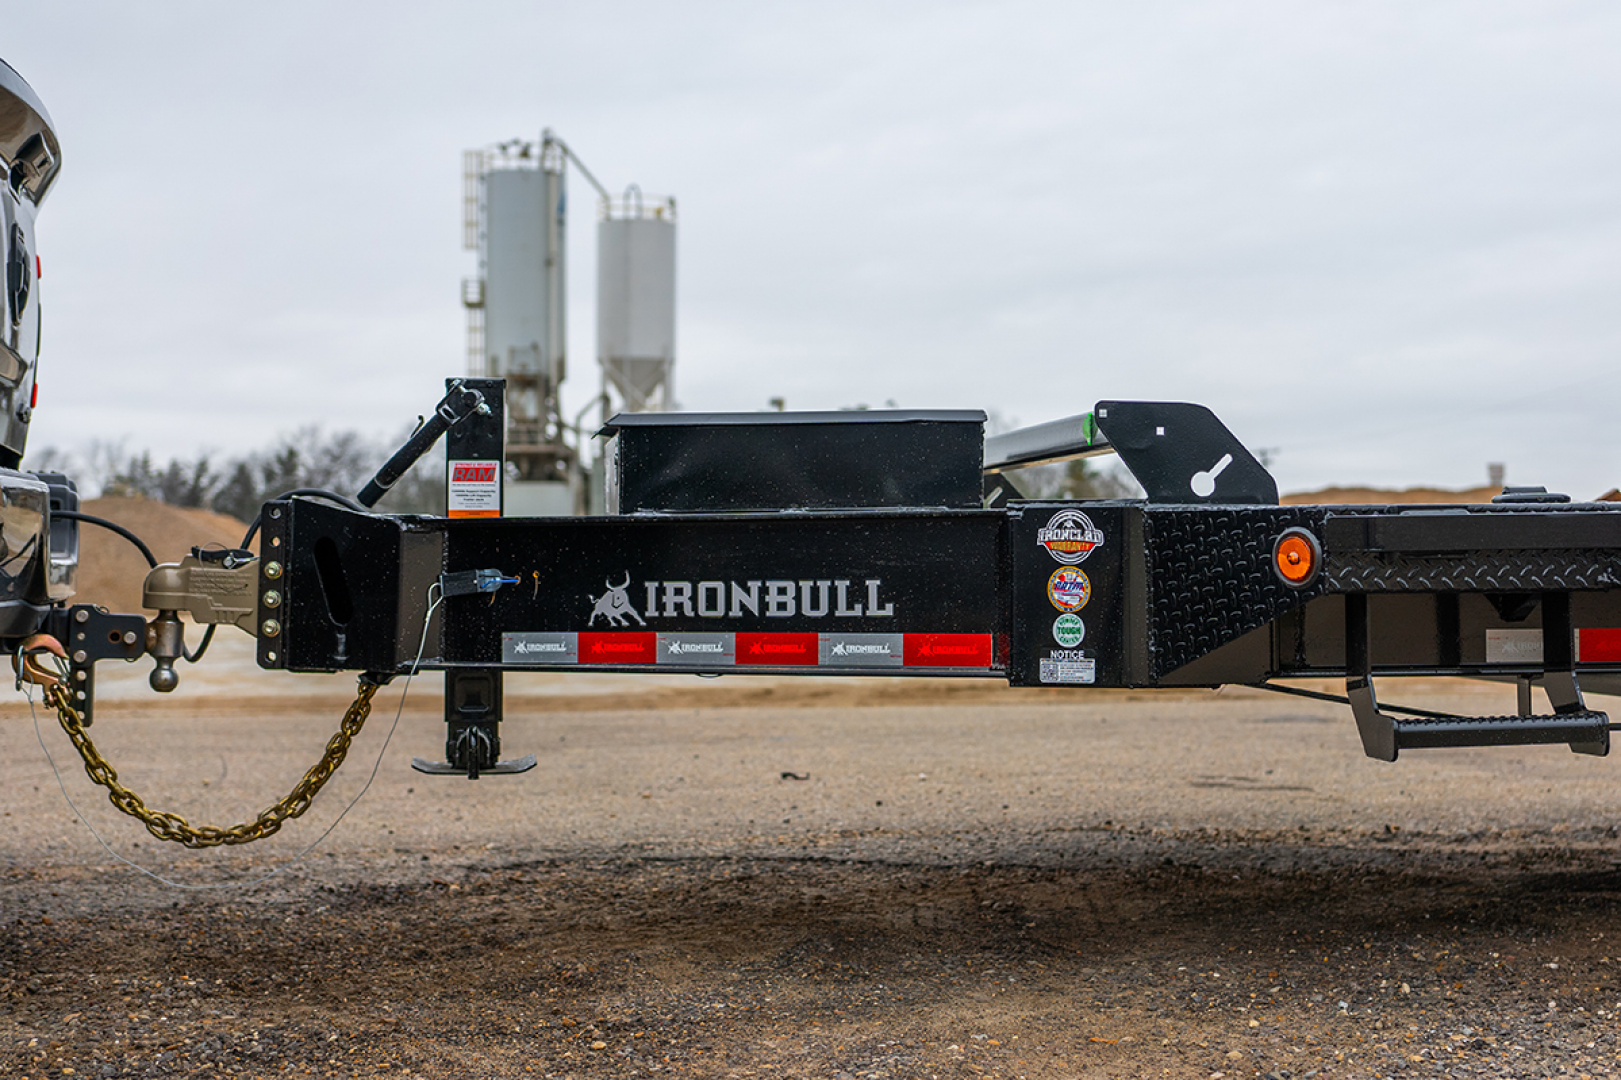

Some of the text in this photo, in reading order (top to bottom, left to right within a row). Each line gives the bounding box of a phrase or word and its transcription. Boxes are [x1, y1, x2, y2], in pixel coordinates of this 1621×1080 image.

[453, 468, 496, 481] RAM
[644, 579, 894, 618] IRONBULL
[682, 642, 724, 653] IRONBULL
[846, 643, 891, 654] IRONBULL
[1050, 649, 1085, 659] NOTICE
